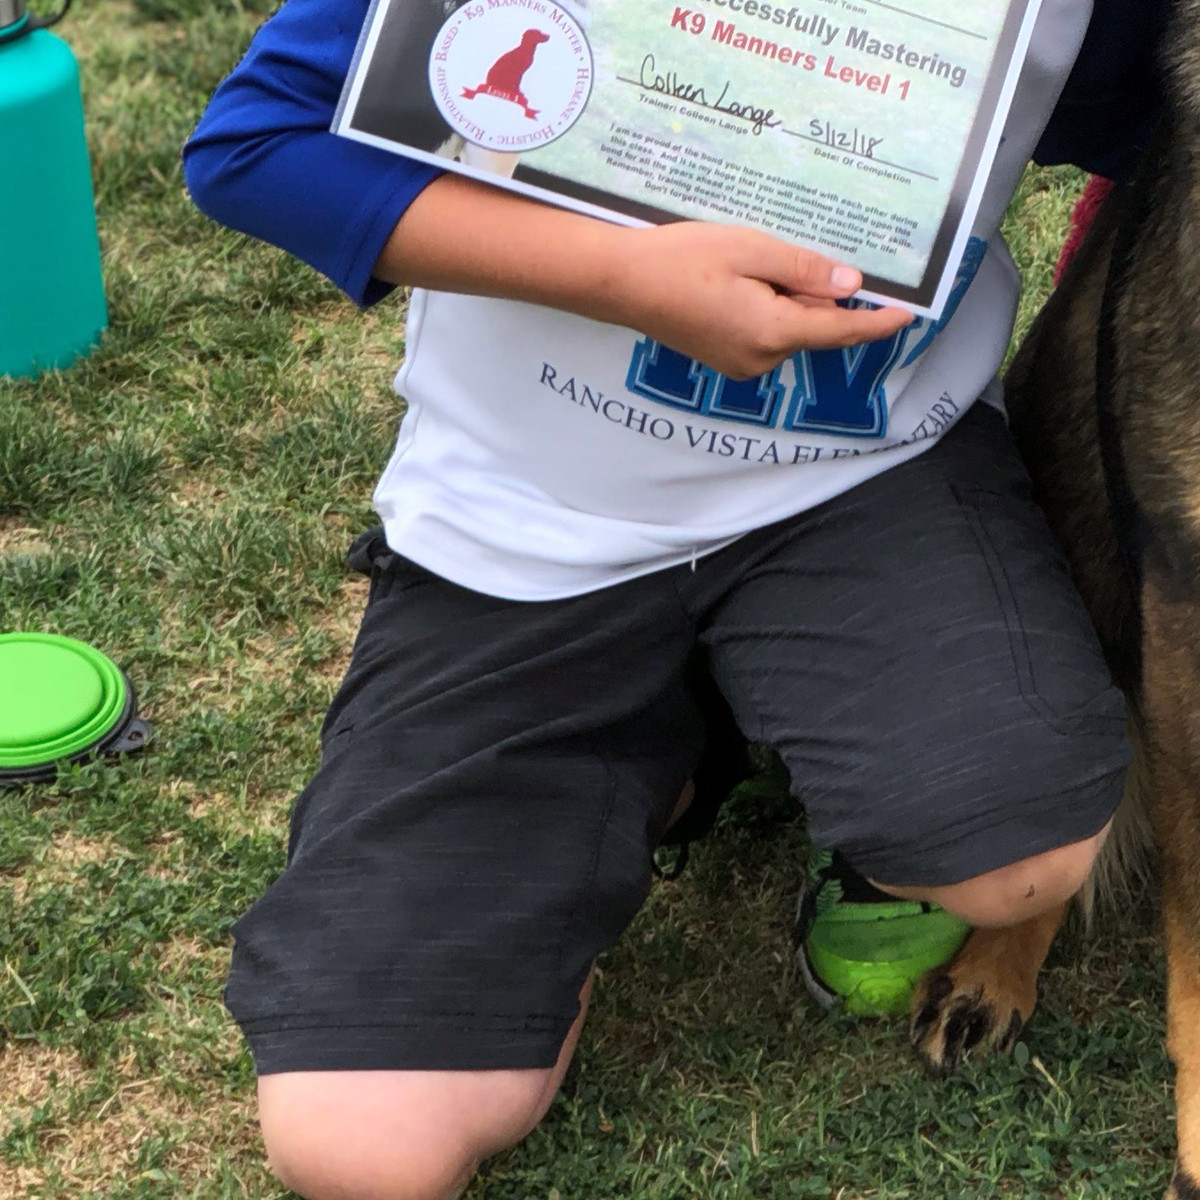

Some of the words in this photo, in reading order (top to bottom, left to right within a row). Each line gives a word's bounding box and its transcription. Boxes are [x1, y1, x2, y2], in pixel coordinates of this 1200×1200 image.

[463, 5, 485, 21] K9
[549, 8, 583, 55] MATTER
[841, 0, 866, 14] Team
[435, 26, 459, 62] BASED
[670, 7, 705, 34] K9
[711, 19, 816, 70] Manners
[823, 55, 890, 94] Level
[898, 80, 910, 100] 1
[845, 26, 966, 88] Mastering
[639, 93, 677, 112] Trainer:
[679, 106, 716, 125] Colleen
[718, 119, 748, 134] Lange
[640, 53, 708, 105] Colleen
[709, 81, 782, 135] Lange
[809, 118, 883, 156] 5/12/18
[813, 147, 839, 161] Date:
[842, 156, 854, 166] Of
[856, 161, 911, 185] Completion
[600, 143, 622, 157] bond
[624, 151, 637, 161] for
[639, 157, 650, 165] all
[652, 160, 666, 171] the
[669, 167, 693, 179] years
[695, 175, 723, 188] ahead
[736, 188, 752, 197] you
[754, 192, 765, 203] by
[767, 198, 814, 219] continuing
[816, 212, 825, 221] to
[826, 217, 864, 233] practice
[865, 230, 886, 240] your
[610, 135, 626, 146] this
[660, 151, 678, 163] And
[679, 157, 686, 165] it
[688, 160, 696, 169] is
[698, 164, 711, 175] my
[713, 168, 736, 181] hope
[738, 176, 756, 187] that
[758, 184, 774, 193] you
[777, 190, 793, 199] will
[794, 195, 833, 212] continue
[835, 207, 844, 215] to
[846, 211, 868, 223] build
[870, 219, 892, 231] upon
[894, 226, 911, 237] this
[615, 127, 630, 135] am
[644, 136, 671, 148] proud
[684, 147, 699, 157] the
[700, 152, 723, 165] bond
[724, 161, 741, 171] you
[742, 166, 763, 178] have
[765, 174, 817, 195] established
[819, 191, 838, 202] with
[840, 198, 862, 209] each
[864, 206, 888, 217] other
[890, 213, 918, 229] during
[657, 174, 692, 192] training
[693, 185, 726, 201] doesn't
[728, 196, 749, 208] have
[811, 222, 818, 230] It
[820, 227, 863, 244] continues
[865, 239, 878, 249] for
[669, 188, 697, 203] forget
[698, 198, 707, 206] to
[709, 202, 733, 215] make
[745, 213, 759, 223] fun
[761, 218, 774, 228] for
[776, 224, 816, 241] everyone
[539, 361, 674, 442] RANCHO
[683, 424, 780, 465] VISTA
